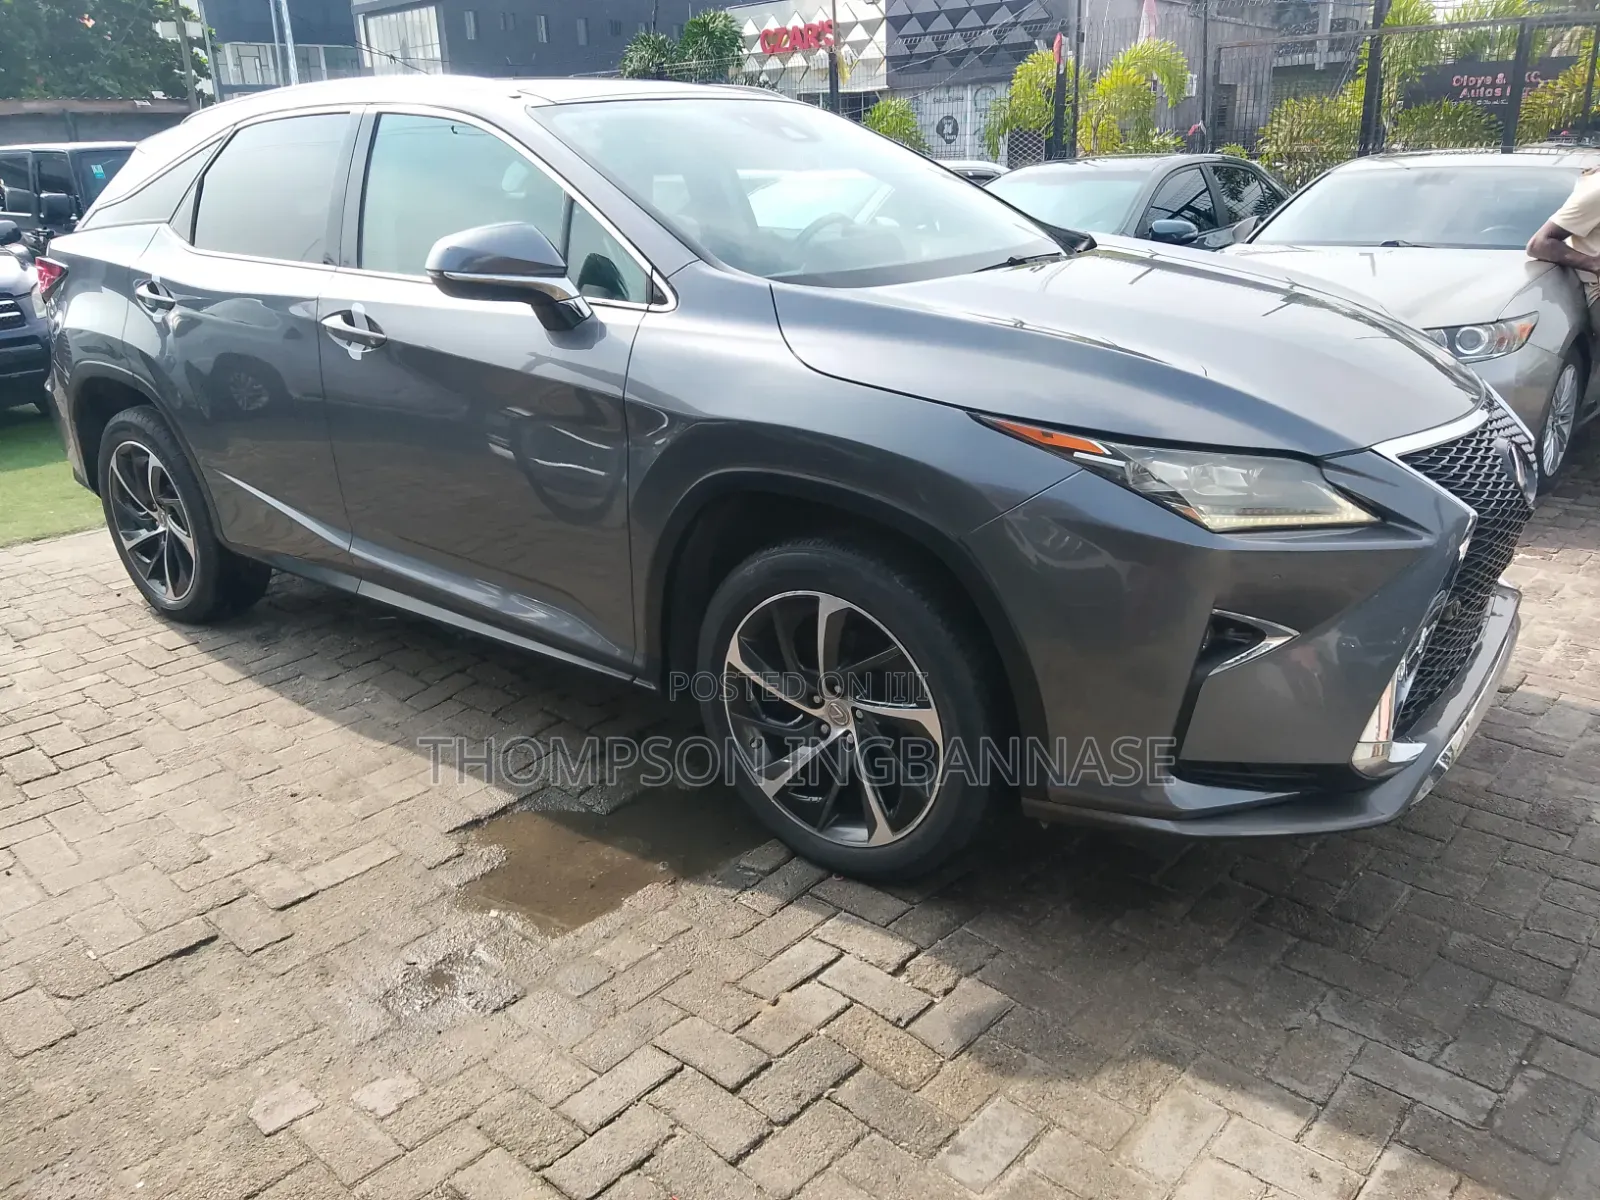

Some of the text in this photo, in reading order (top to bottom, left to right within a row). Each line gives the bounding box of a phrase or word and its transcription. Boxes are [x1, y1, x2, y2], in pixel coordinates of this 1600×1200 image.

[760, 19, 834, 54] CZAR'S
[1496, 72, 1506, 83] &
[1459, 86, 1501, 98] Autos
